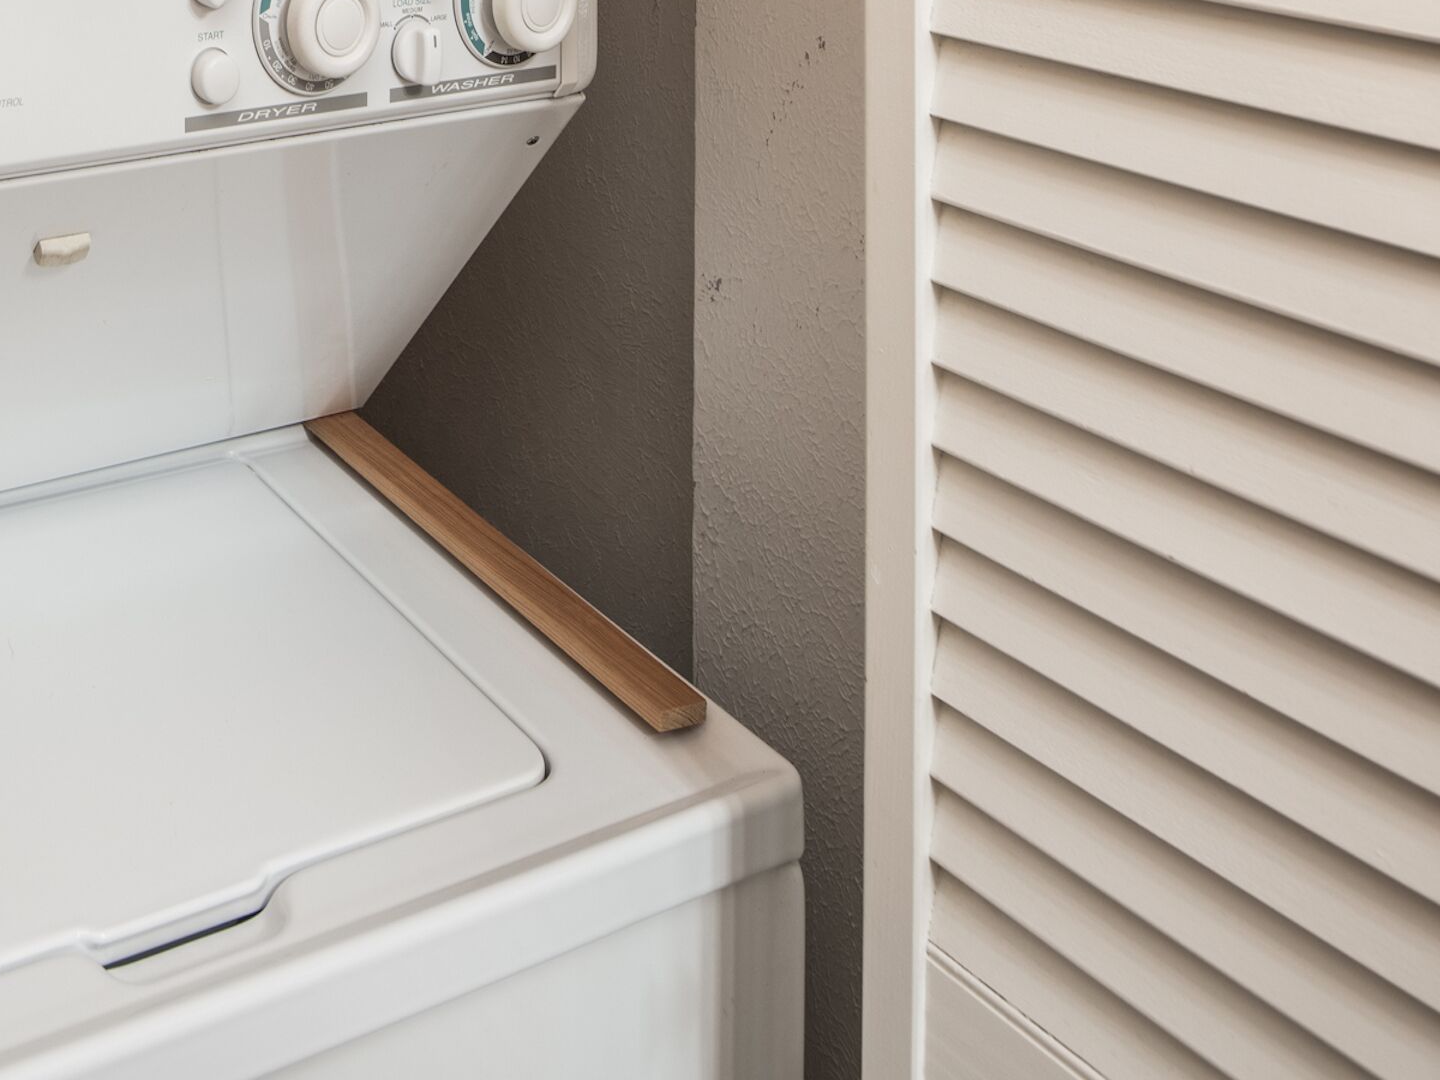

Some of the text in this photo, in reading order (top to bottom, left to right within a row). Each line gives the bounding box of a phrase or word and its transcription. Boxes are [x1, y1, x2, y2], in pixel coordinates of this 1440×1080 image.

[430, 14, 447, 22] LARGE
[197, 30, 224, 42] START
[263, 39, 272, 51] 10
[272, 60, 283, 72] 20
[430, 73, 515, 94] WASHER
[237, 102, 318, 123] DRYER
